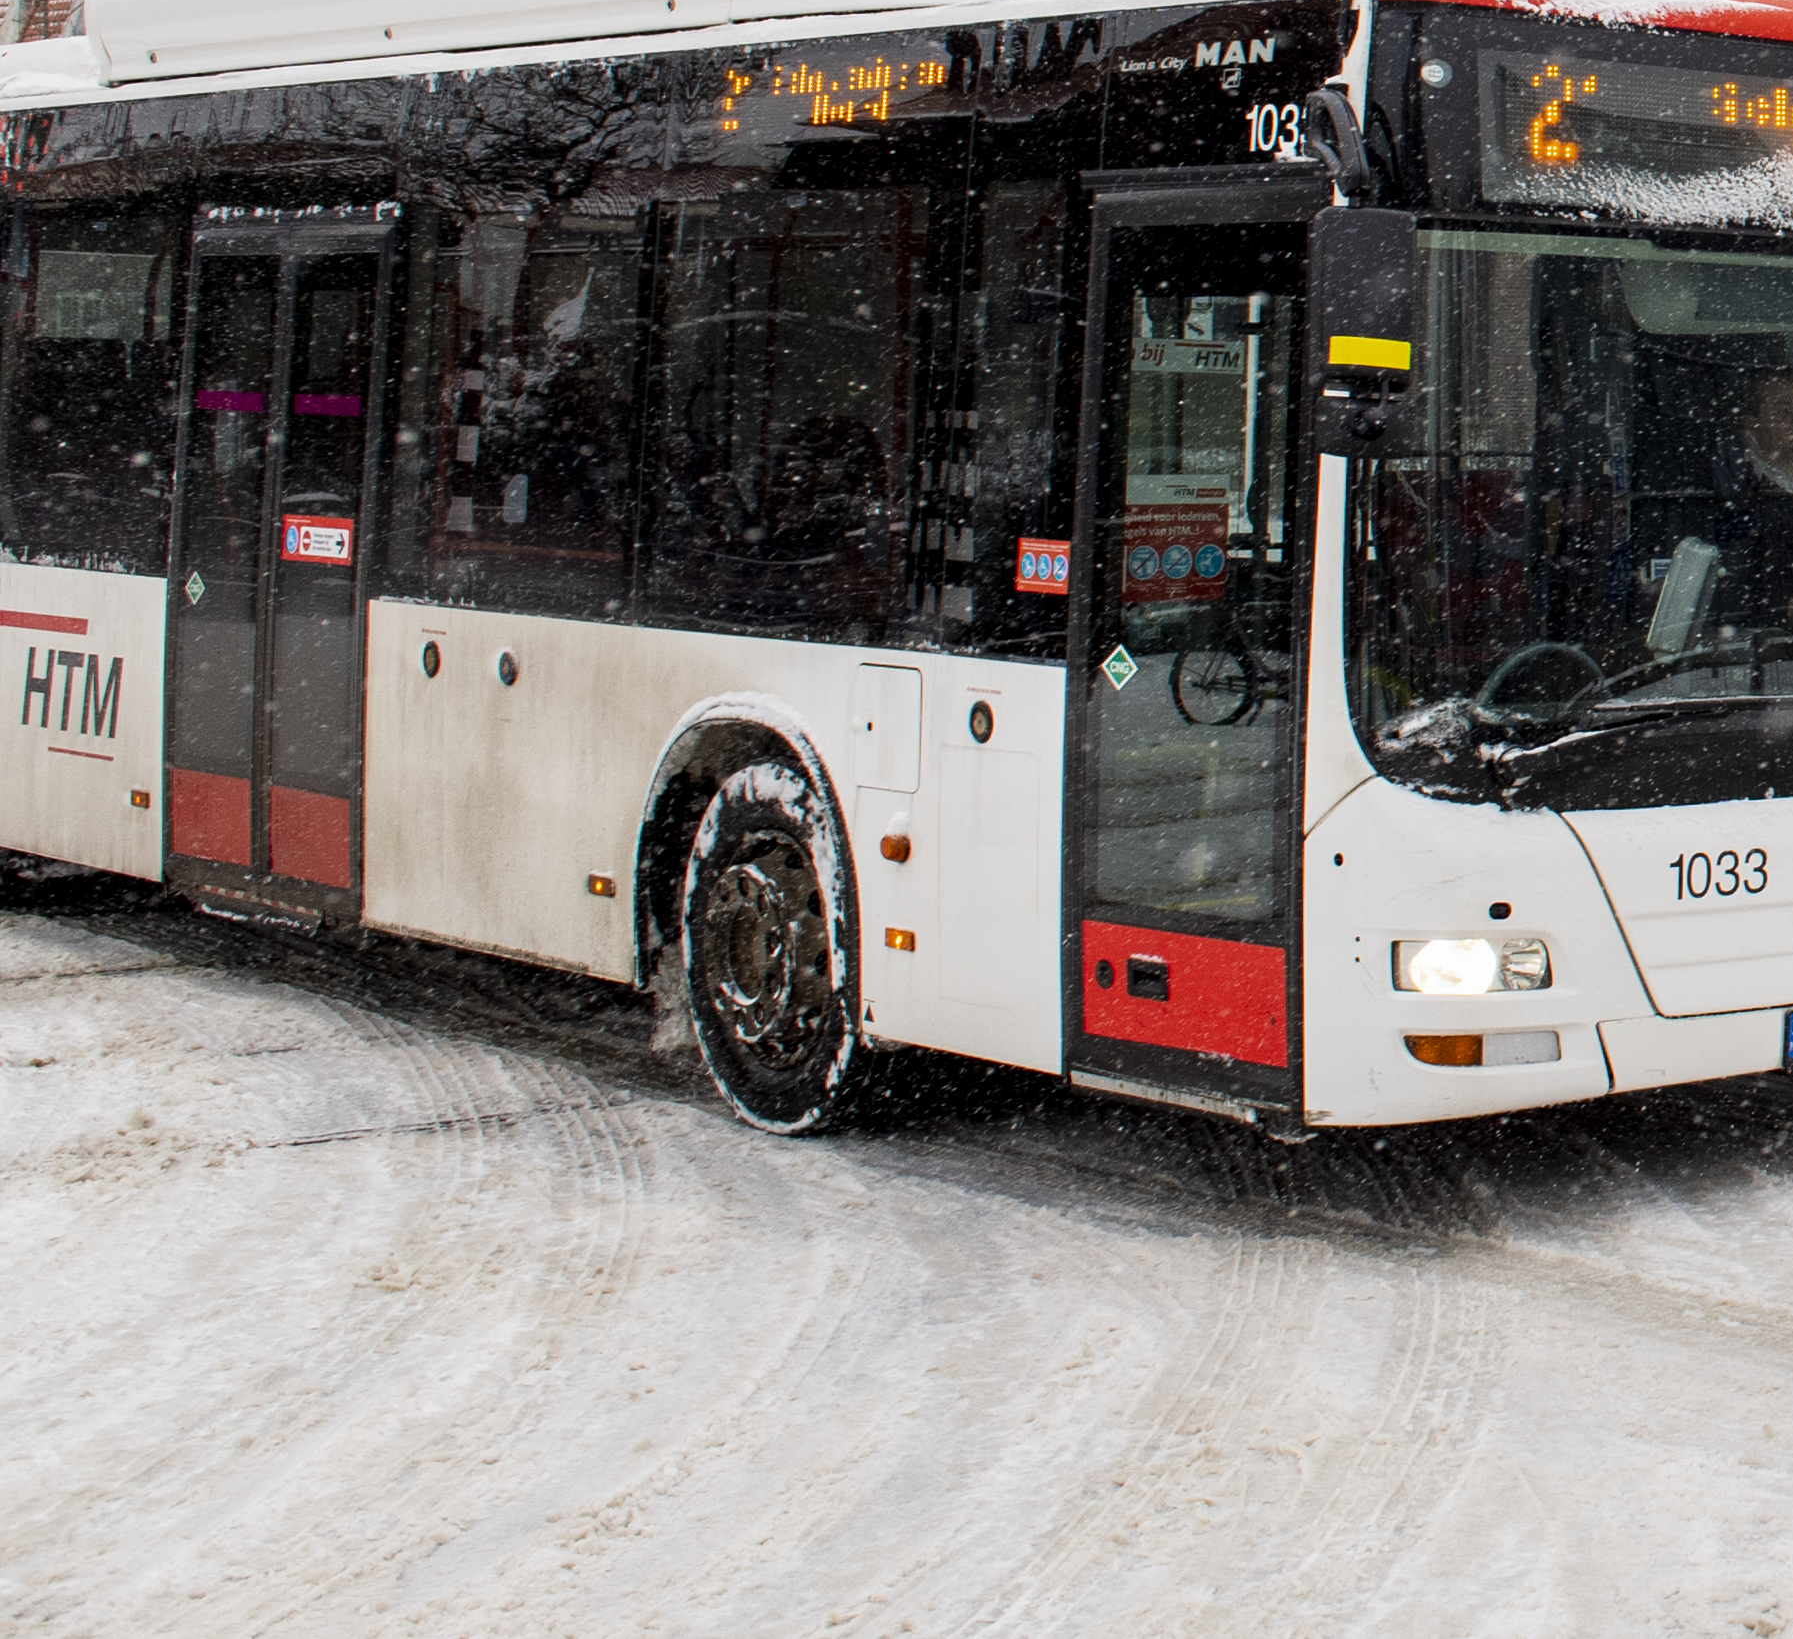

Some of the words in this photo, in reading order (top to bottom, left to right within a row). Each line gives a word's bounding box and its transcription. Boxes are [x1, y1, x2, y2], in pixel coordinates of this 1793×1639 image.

[1160, 57, 1189, 75] City
[1195, 38, 1275, 67] MAN
[1246, 103, 1307, 153] 103
[1195, 350, 1240, 368] HTM
[21, 646, 124, 739] HTM
[1669, 847, 1769, 901] 1033
